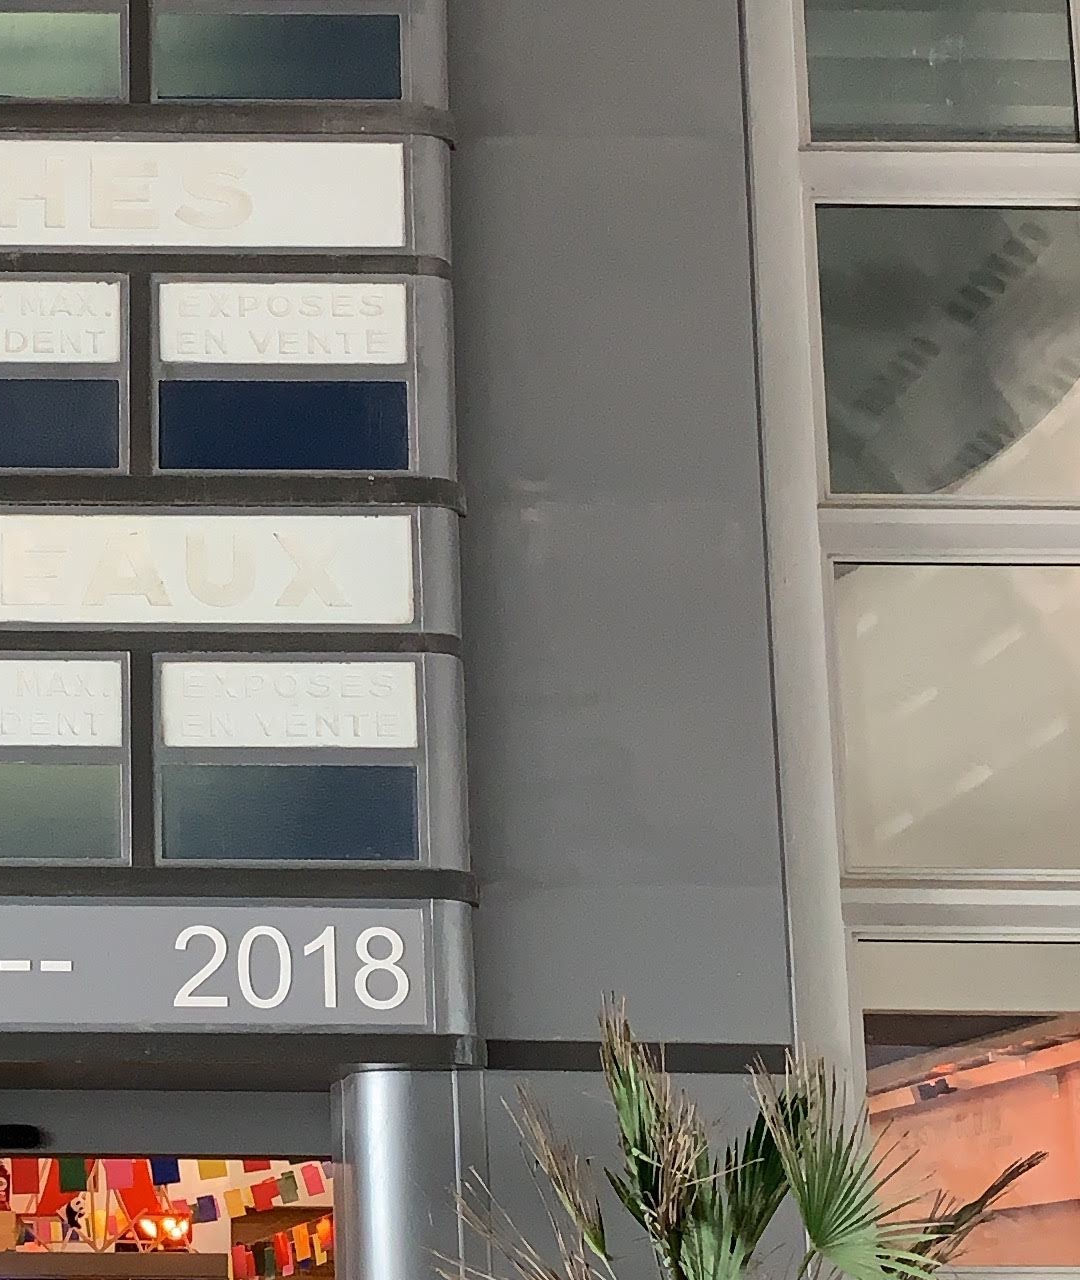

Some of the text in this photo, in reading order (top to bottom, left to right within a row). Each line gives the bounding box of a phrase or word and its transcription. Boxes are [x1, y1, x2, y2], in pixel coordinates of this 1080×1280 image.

[176, 329, 392, 355] EN VENTE
[182, 711, 400, 738] EN VENTE
[173, 925, 409, 1010] 2018
